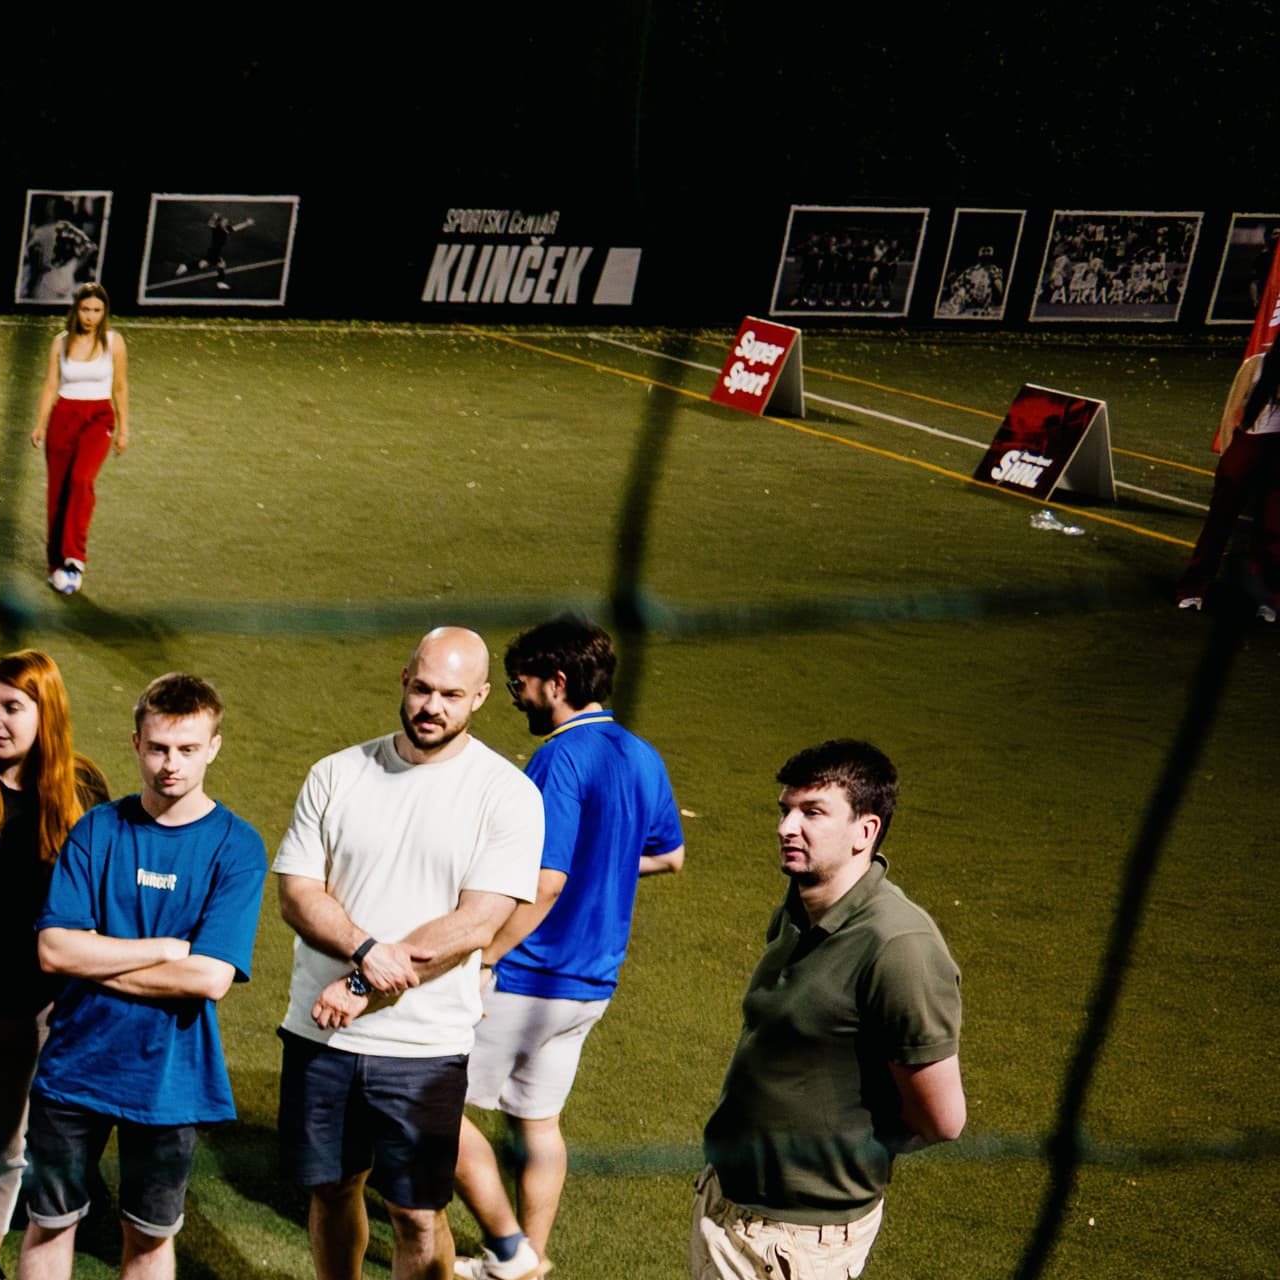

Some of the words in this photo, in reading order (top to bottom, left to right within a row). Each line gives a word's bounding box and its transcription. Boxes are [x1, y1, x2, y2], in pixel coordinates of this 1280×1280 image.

[421, 236, 593, 304] KLINČEK
[734, 330, 785, 366] Super
[724, 361, 771, 397] Sport
